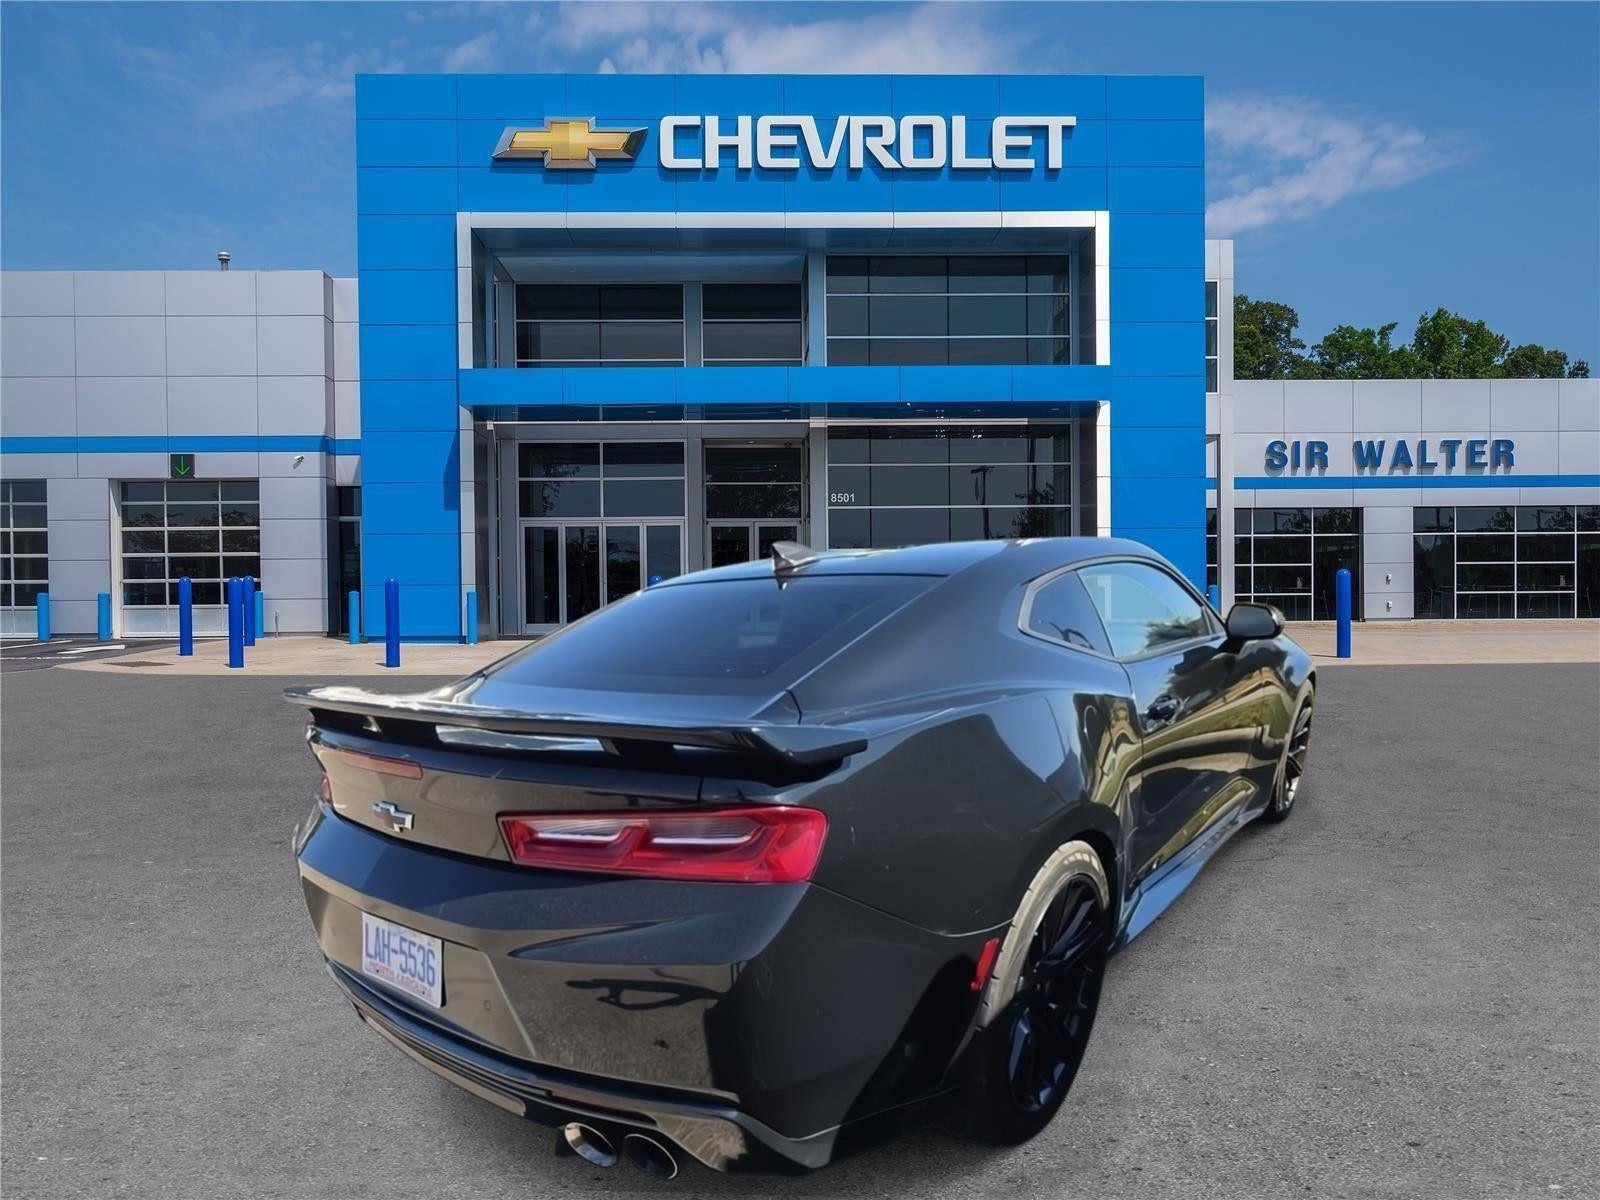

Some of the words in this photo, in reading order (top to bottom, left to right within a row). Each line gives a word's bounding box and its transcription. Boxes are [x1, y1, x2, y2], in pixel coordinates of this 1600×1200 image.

[659, 115, 1077, 169] CHEVROLET
[1265, 440, 1329, 470] SIR
[1354, 439, 1515, 468] WALTER
[830, 493, 855, 503] 8501
[364, 922, 436, 987] LAH-5536
